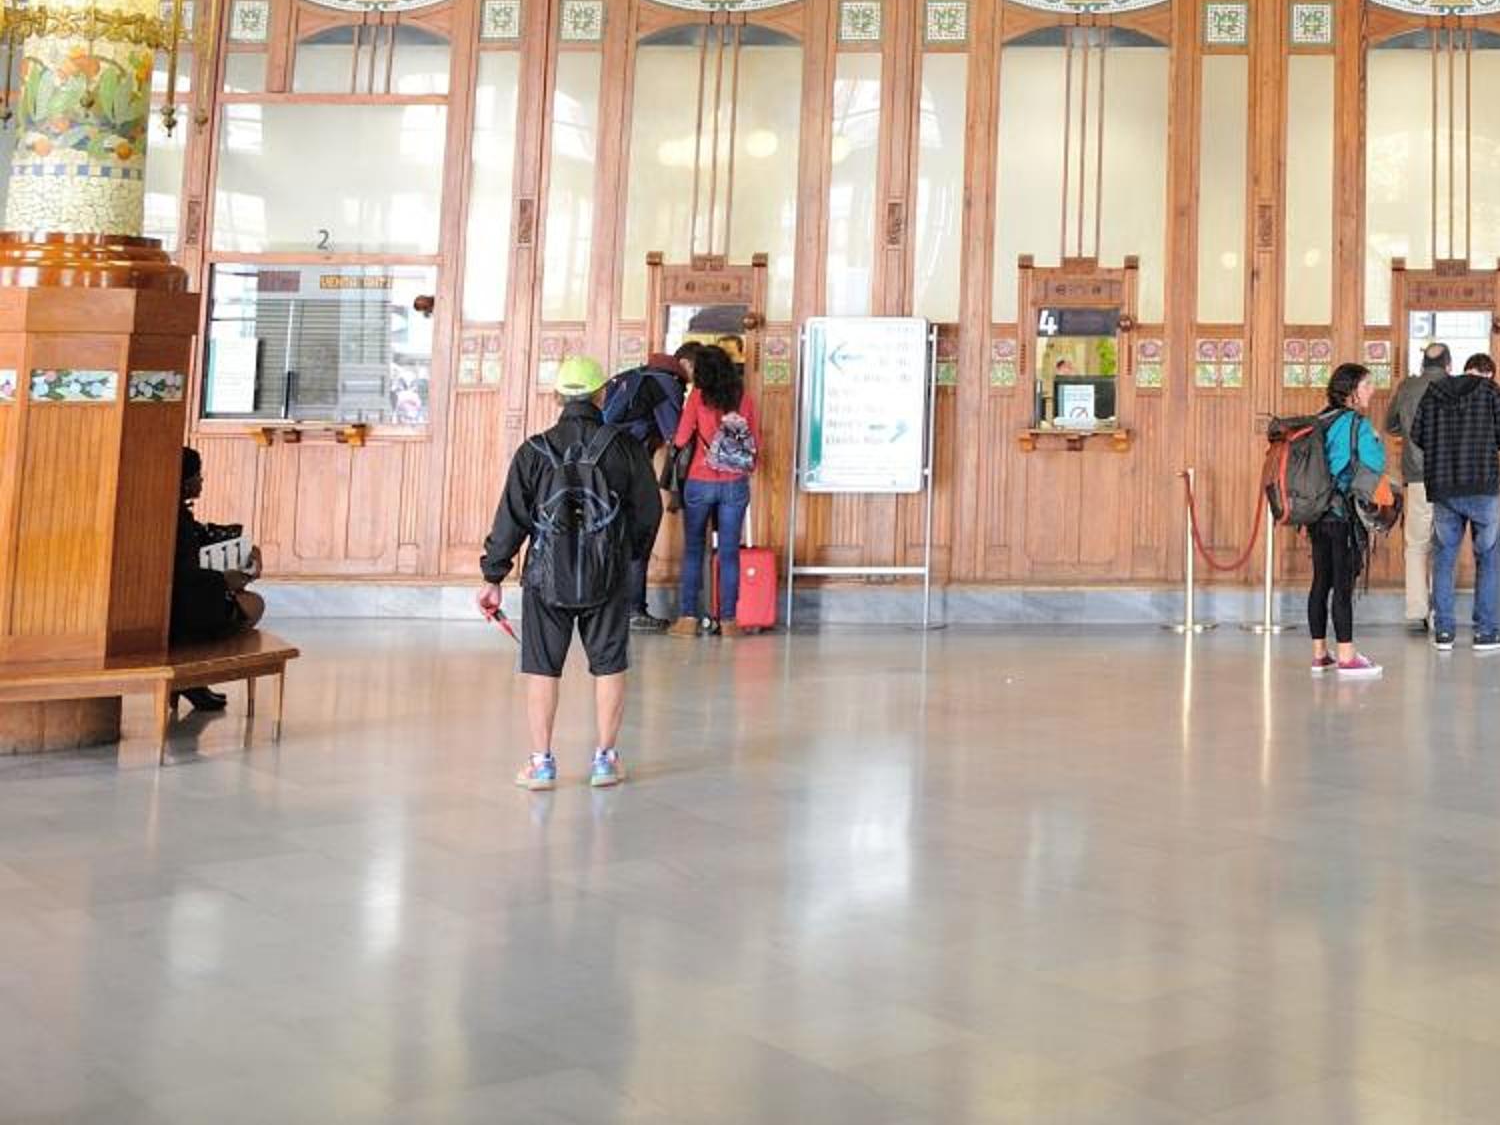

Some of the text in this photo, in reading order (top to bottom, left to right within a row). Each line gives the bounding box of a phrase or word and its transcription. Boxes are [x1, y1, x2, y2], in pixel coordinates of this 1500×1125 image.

[318, 230, 330, 250] 2
[1039, 309, 1058, 335] 4
[1413, 313, 1429, 337] 5
